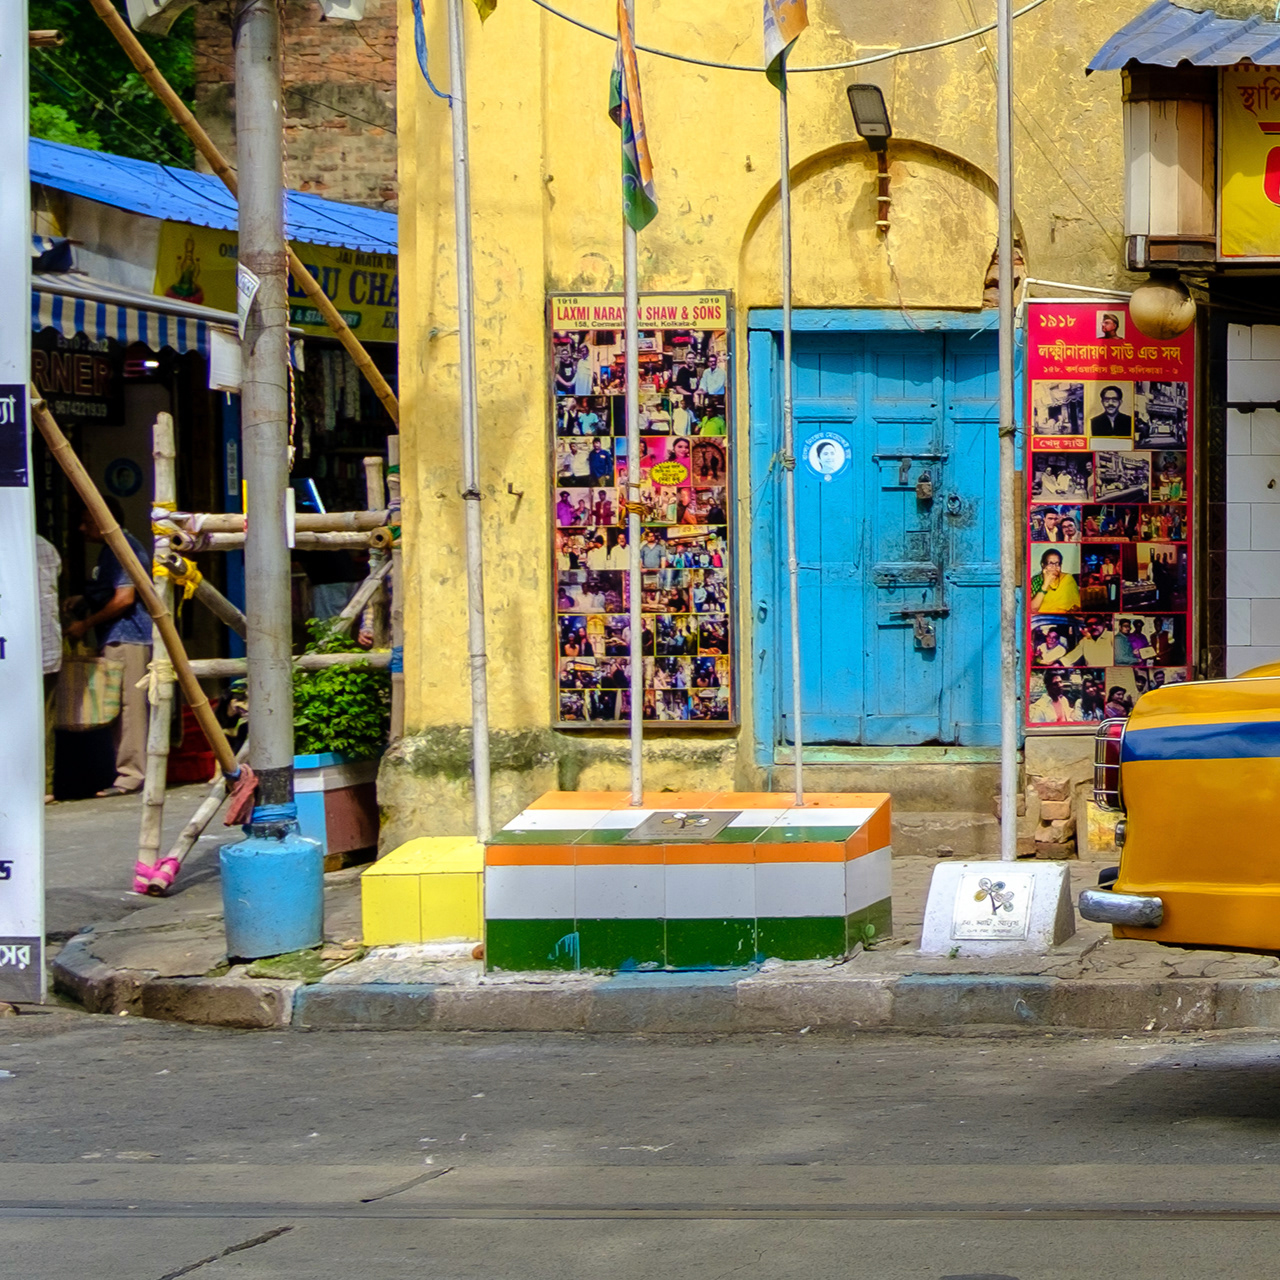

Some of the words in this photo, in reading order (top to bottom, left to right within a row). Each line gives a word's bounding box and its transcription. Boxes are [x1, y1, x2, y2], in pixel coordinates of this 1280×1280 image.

[557, 306, 590, 321] LAXMI
[646, 306, 678, 320] SHAW
[681, 306, 689, 319] &
[692, 305, 722, 320] SONS
[1039, 314, 1076, 327] ১৯১৮
[1037, 339, 1107, 363] লক্ষ্মীনারায়ণ
[1110, 343, 1135, 360] সাউ
[1137, 346, 1158, 360] এন্ড
